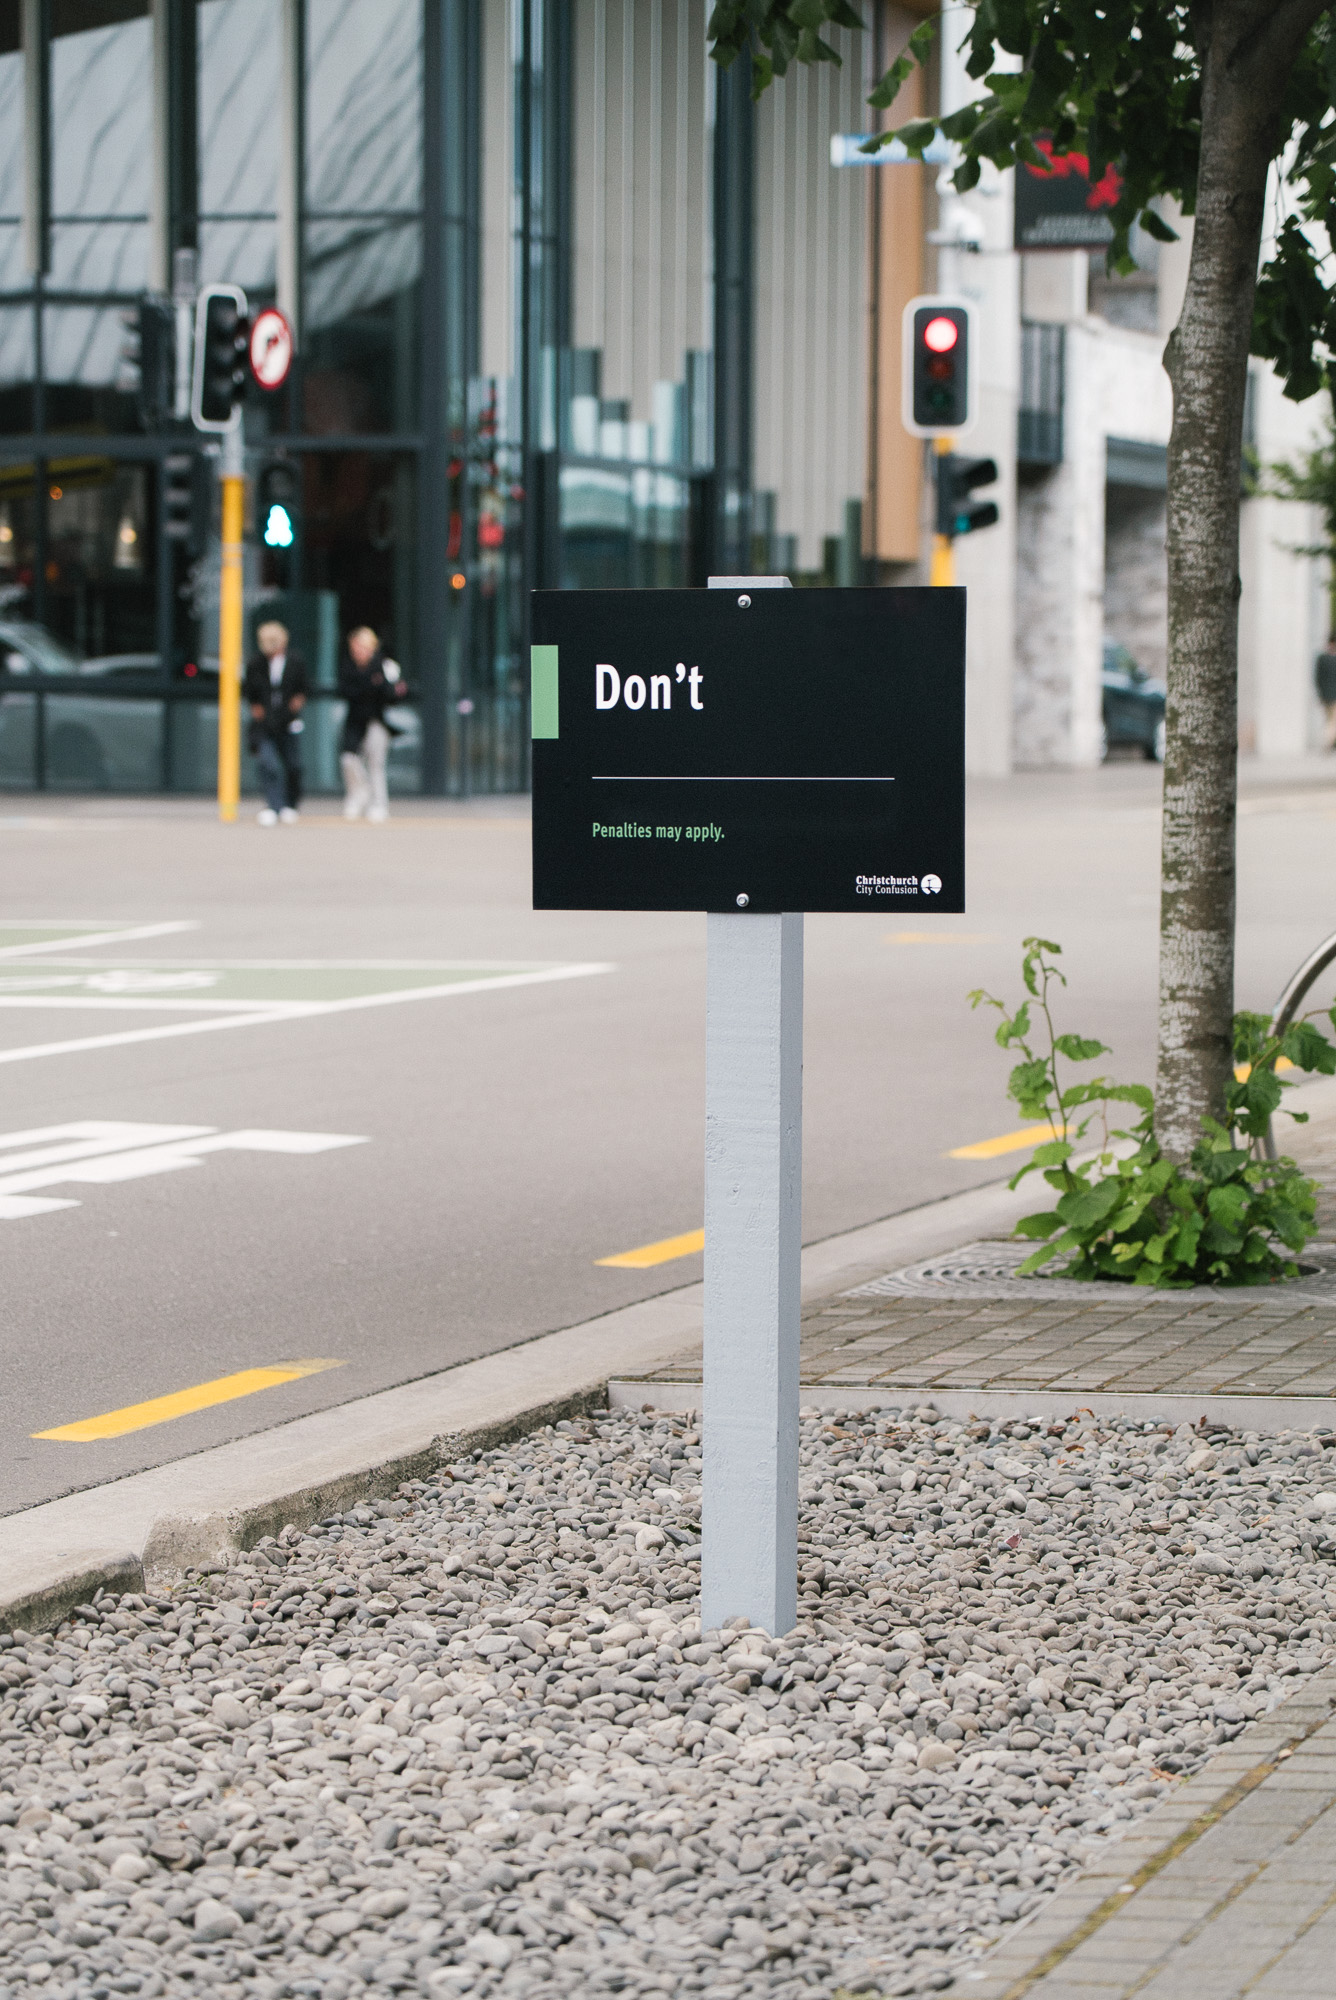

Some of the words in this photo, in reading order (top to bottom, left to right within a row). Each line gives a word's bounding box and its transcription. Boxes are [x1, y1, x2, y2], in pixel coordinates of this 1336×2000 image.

[595, 662, 704, 711] Don't
[592, 822, 652, 839] Penalties
[655, 826, 683, 843] may
[685, 822, 725, 843] apply.
[856, 875, 919, 885] Christchurch
[856, 885, 873, 896] City
[875, 885, 918, 895] Confusion
